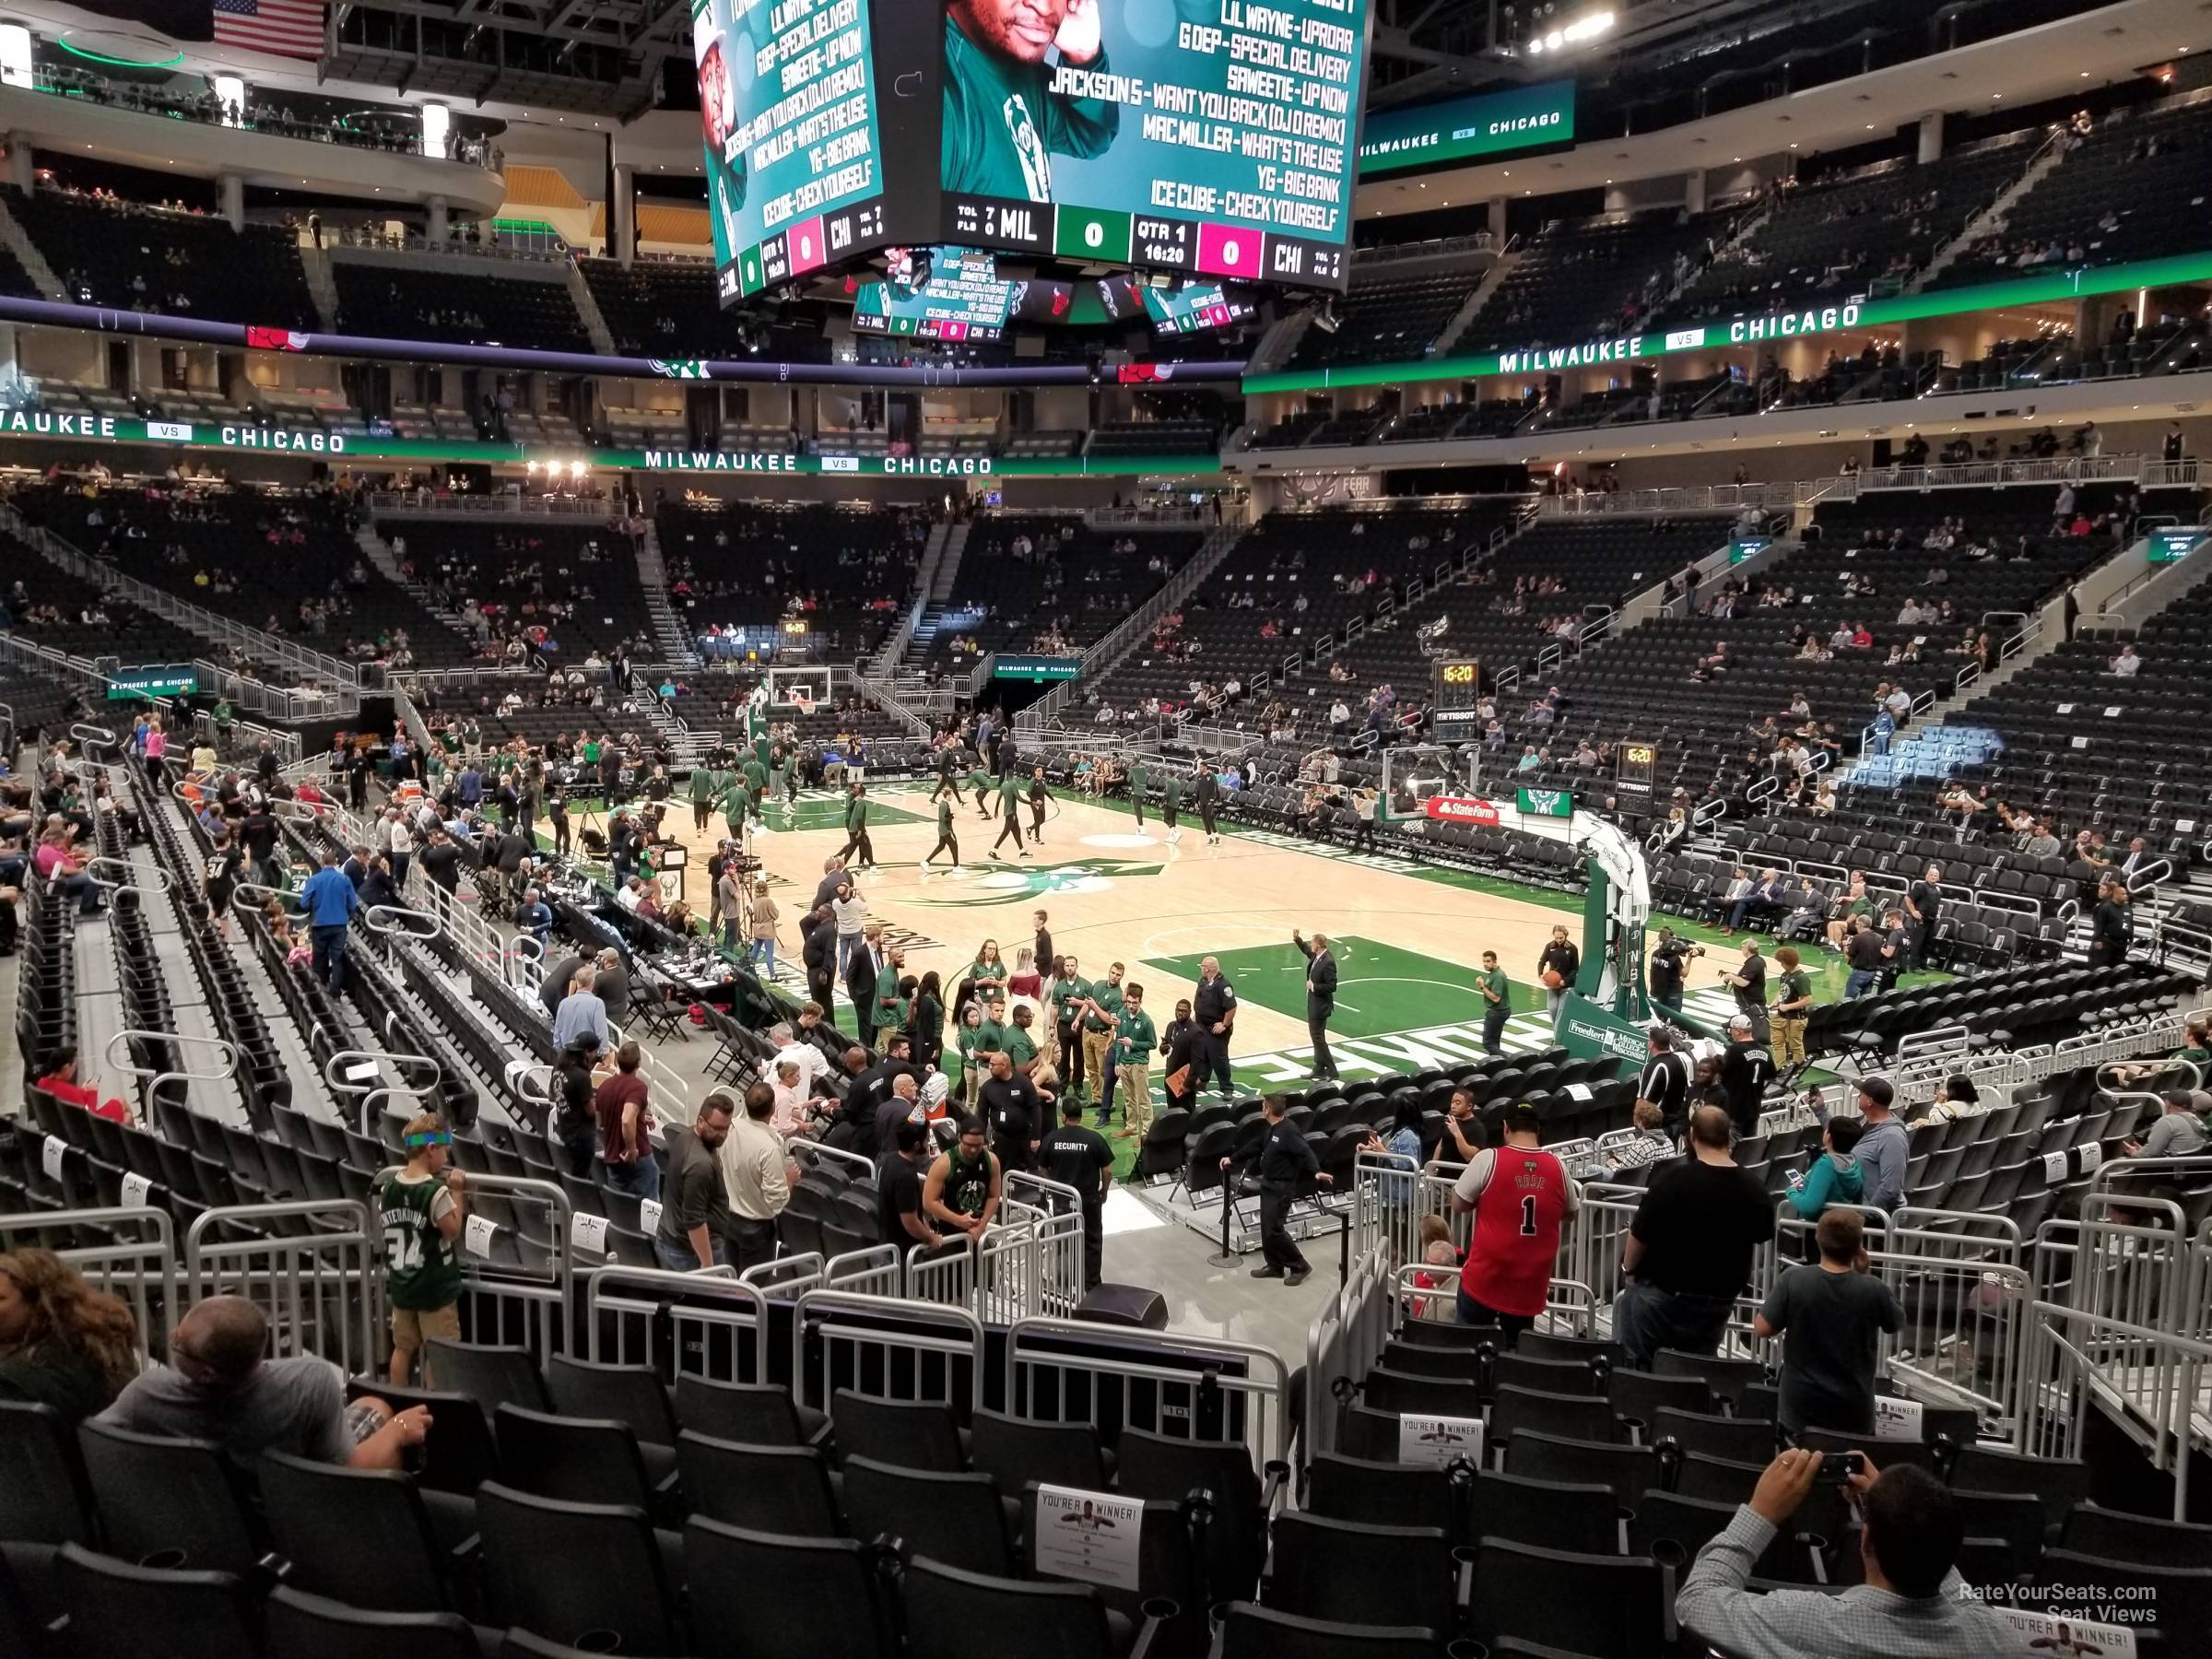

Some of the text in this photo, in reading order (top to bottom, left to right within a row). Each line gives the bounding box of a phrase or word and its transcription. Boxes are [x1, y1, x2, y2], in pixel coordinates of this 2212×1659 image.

[779, 21, 814, 61] SPECIAL
[813, 1, 858, 43] DELIVERY
[1221, 0, 1354, 53] LIL WAYNE UPROAR
[825, 39, 841, 68] UP
[841, 27, 862, 61] NOW
[1179, 22, 1352, 83] G DEP SPECIAL DELIVERY
[1048, 66, 1129, 103] JACKSON
[1153, 83, 1197, 114] WANT
[1198, 90, 1229, 120] YOU
[1230, 97, 1268, 127] BACK
[1227, 65, 1348, 113] SAWEETIE UP NOW
[847, 93, 868, 129] USE
[1488, 112, 1560, 135] CHICAGO
[842, 126, 870, 161] BANK
[1143, 113, 1343, 173] MAC MILLER WHAT'S THE USE
[824, 159, 872, 201] YOURSELF
[1257, 165, 1341, 203] YG BIG BANK
[985, 206, 994, 219] 7
[1150, 179, 1338, 231] ICE CUBE CHECK YOURSELF
[830, 217, 852, 250] CHI
[984, 222, 994, 236] 0
[1000, 208, 1037, 241] MIL
[1084, 222, 1103, 247] 0
[1137, 220, 1186, 242] QTR 1
[777, 238, 783, 254] 1
[800, 235, 812, 260] 0
[1144, 244, 1184, 264] 16:20
[1222, 241, 1240, 265] 0
[1274, 244, 1302, 274] CHI
[1333, 253, 1340, 265] 7
[747, 260, 755, 283] 0
[1332, 266, 1339, 278] 0
[900, 320, 907, 331] 0
[1498, 304, 1860, 373] MILWAUKEE VS CHICAGO
[159, 426, 179, 438] VS
[221, 427, 345, 453] CHICAGO
[645, 451, 992, 474] MILWAUKEE VS CHICAGO
[1343, 477, 1370, 491] FEAR
[1443, 665, 1472, 681] 16:20
[1448, 712, 1475, 720] TISSOT
[207, 863, 224, 879] 34
[1571, 1021, 1605, 1041] Froedtert
[1752, 1063, 1759, 1083] 1
[1053, 1141, 1088, 1152] SECURITY
[967, 1180, 977, 1190] 34
[1514, 1174, 1546, 1189] ROSE
[1520, 1194, 1537, 1236] 1
[384, 1228, 425, 1270] 34
[1889, 1405, 1918, 1417] WINNER!
[1404, 1420, 1479, 1436] YOU'RE A WINNER!
[1041, 1494, 1136, 1521] YOU'RE A WINNER!
[2045, 1623, 2053, 1635] A
[2075, 1627, 2128, 1648] WINNER!
